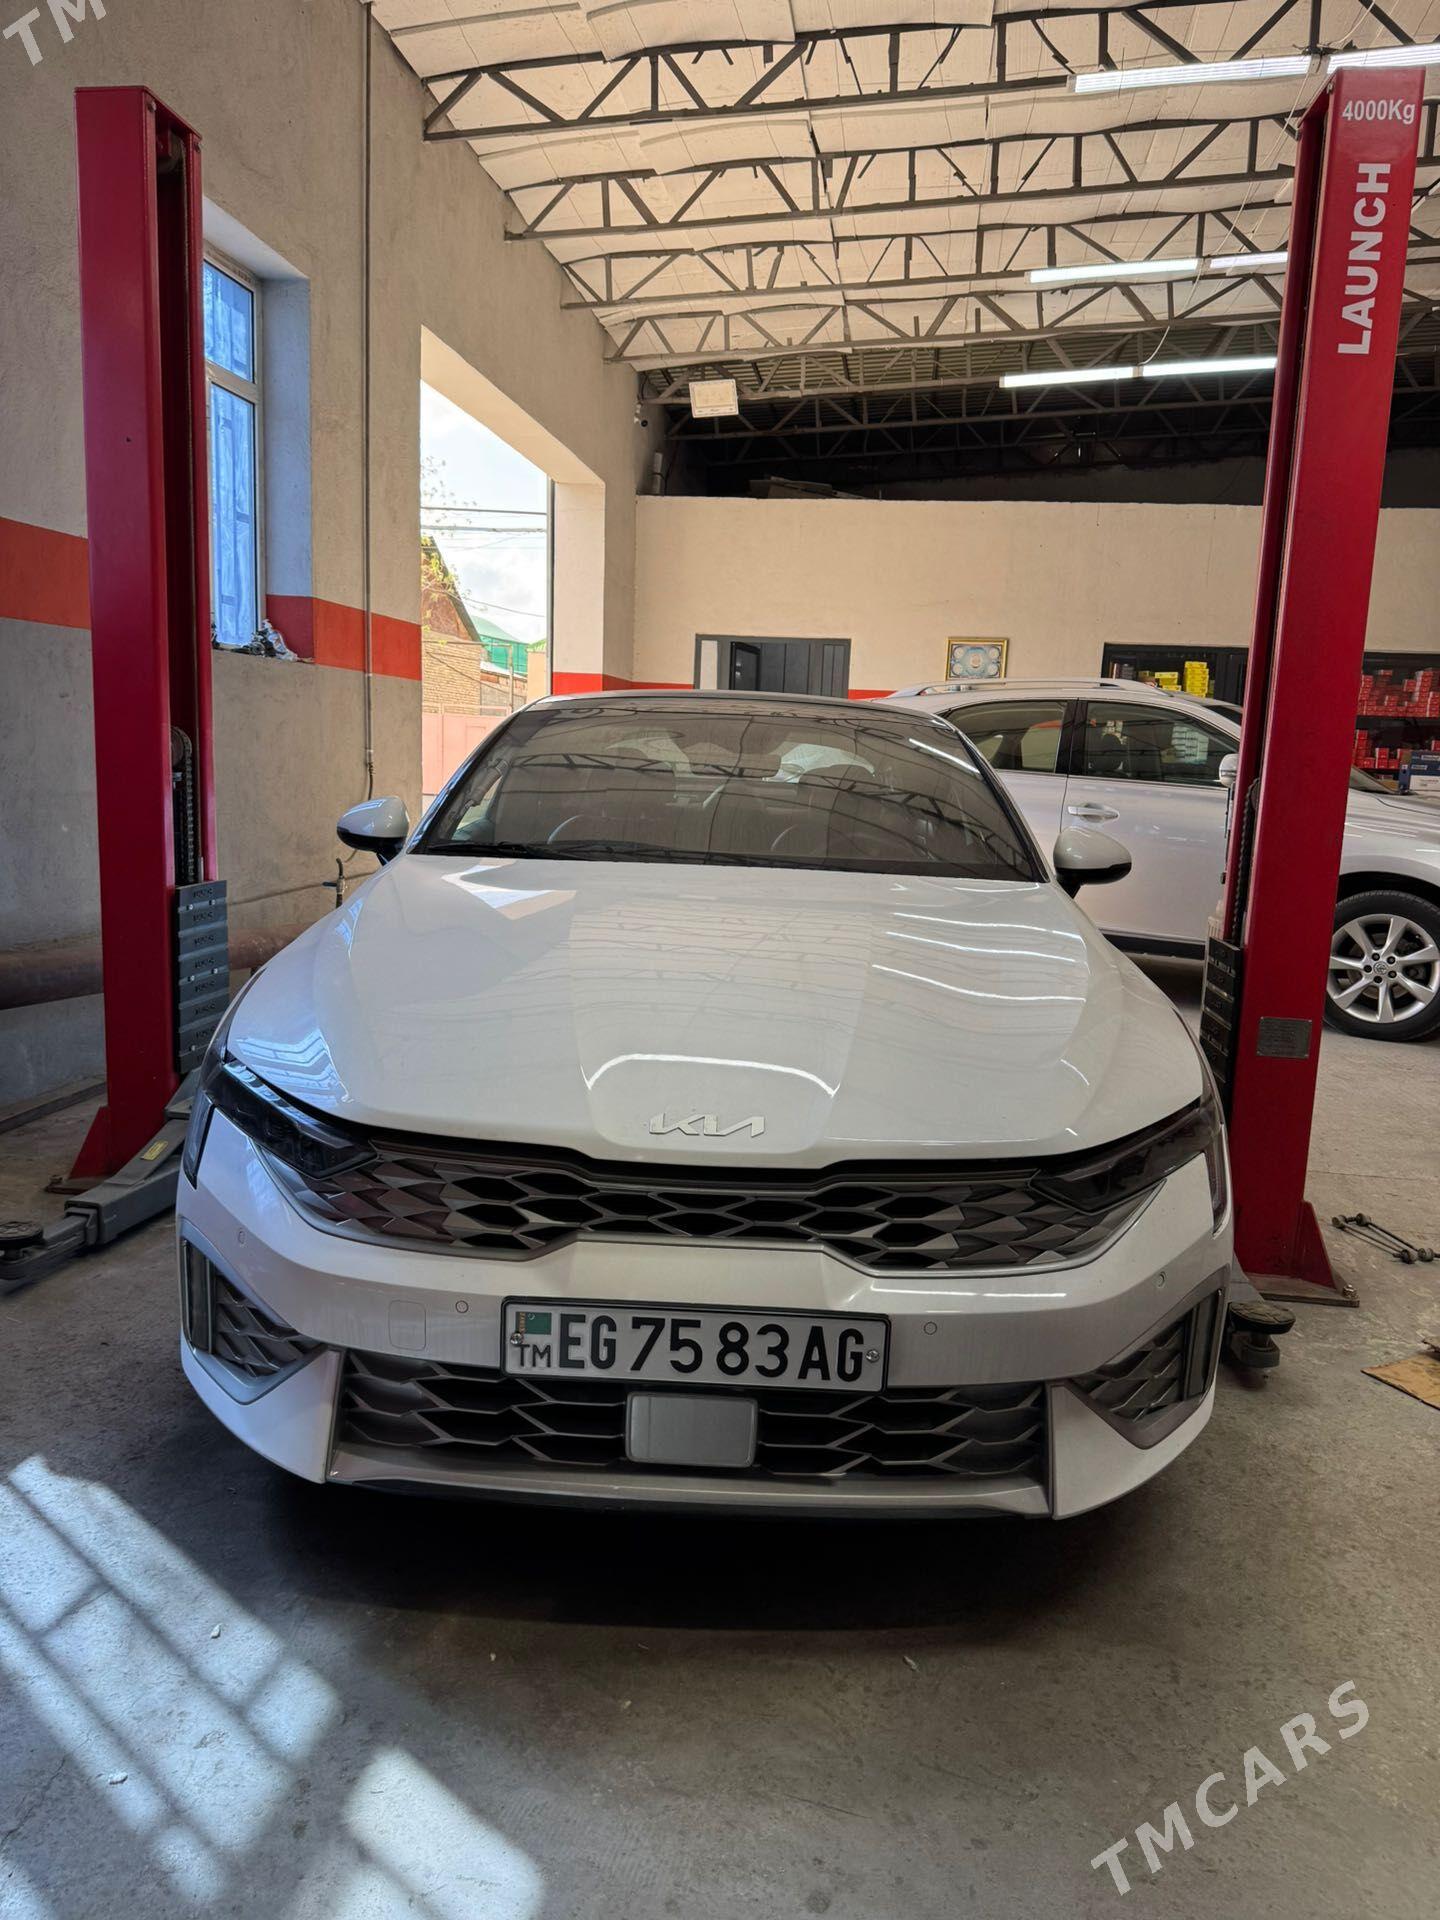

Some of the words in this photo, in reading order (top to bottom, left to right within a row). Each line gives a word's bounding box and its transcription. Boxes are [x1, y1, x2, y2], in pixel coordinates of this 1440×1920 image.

[1342, 98, 1416, 125] 4000Kg
[1337, 162, 1391, 355] LAUNCH
[649, 1112, 765, 1138] KIA
[517, 1343, 552, 1368] TM
